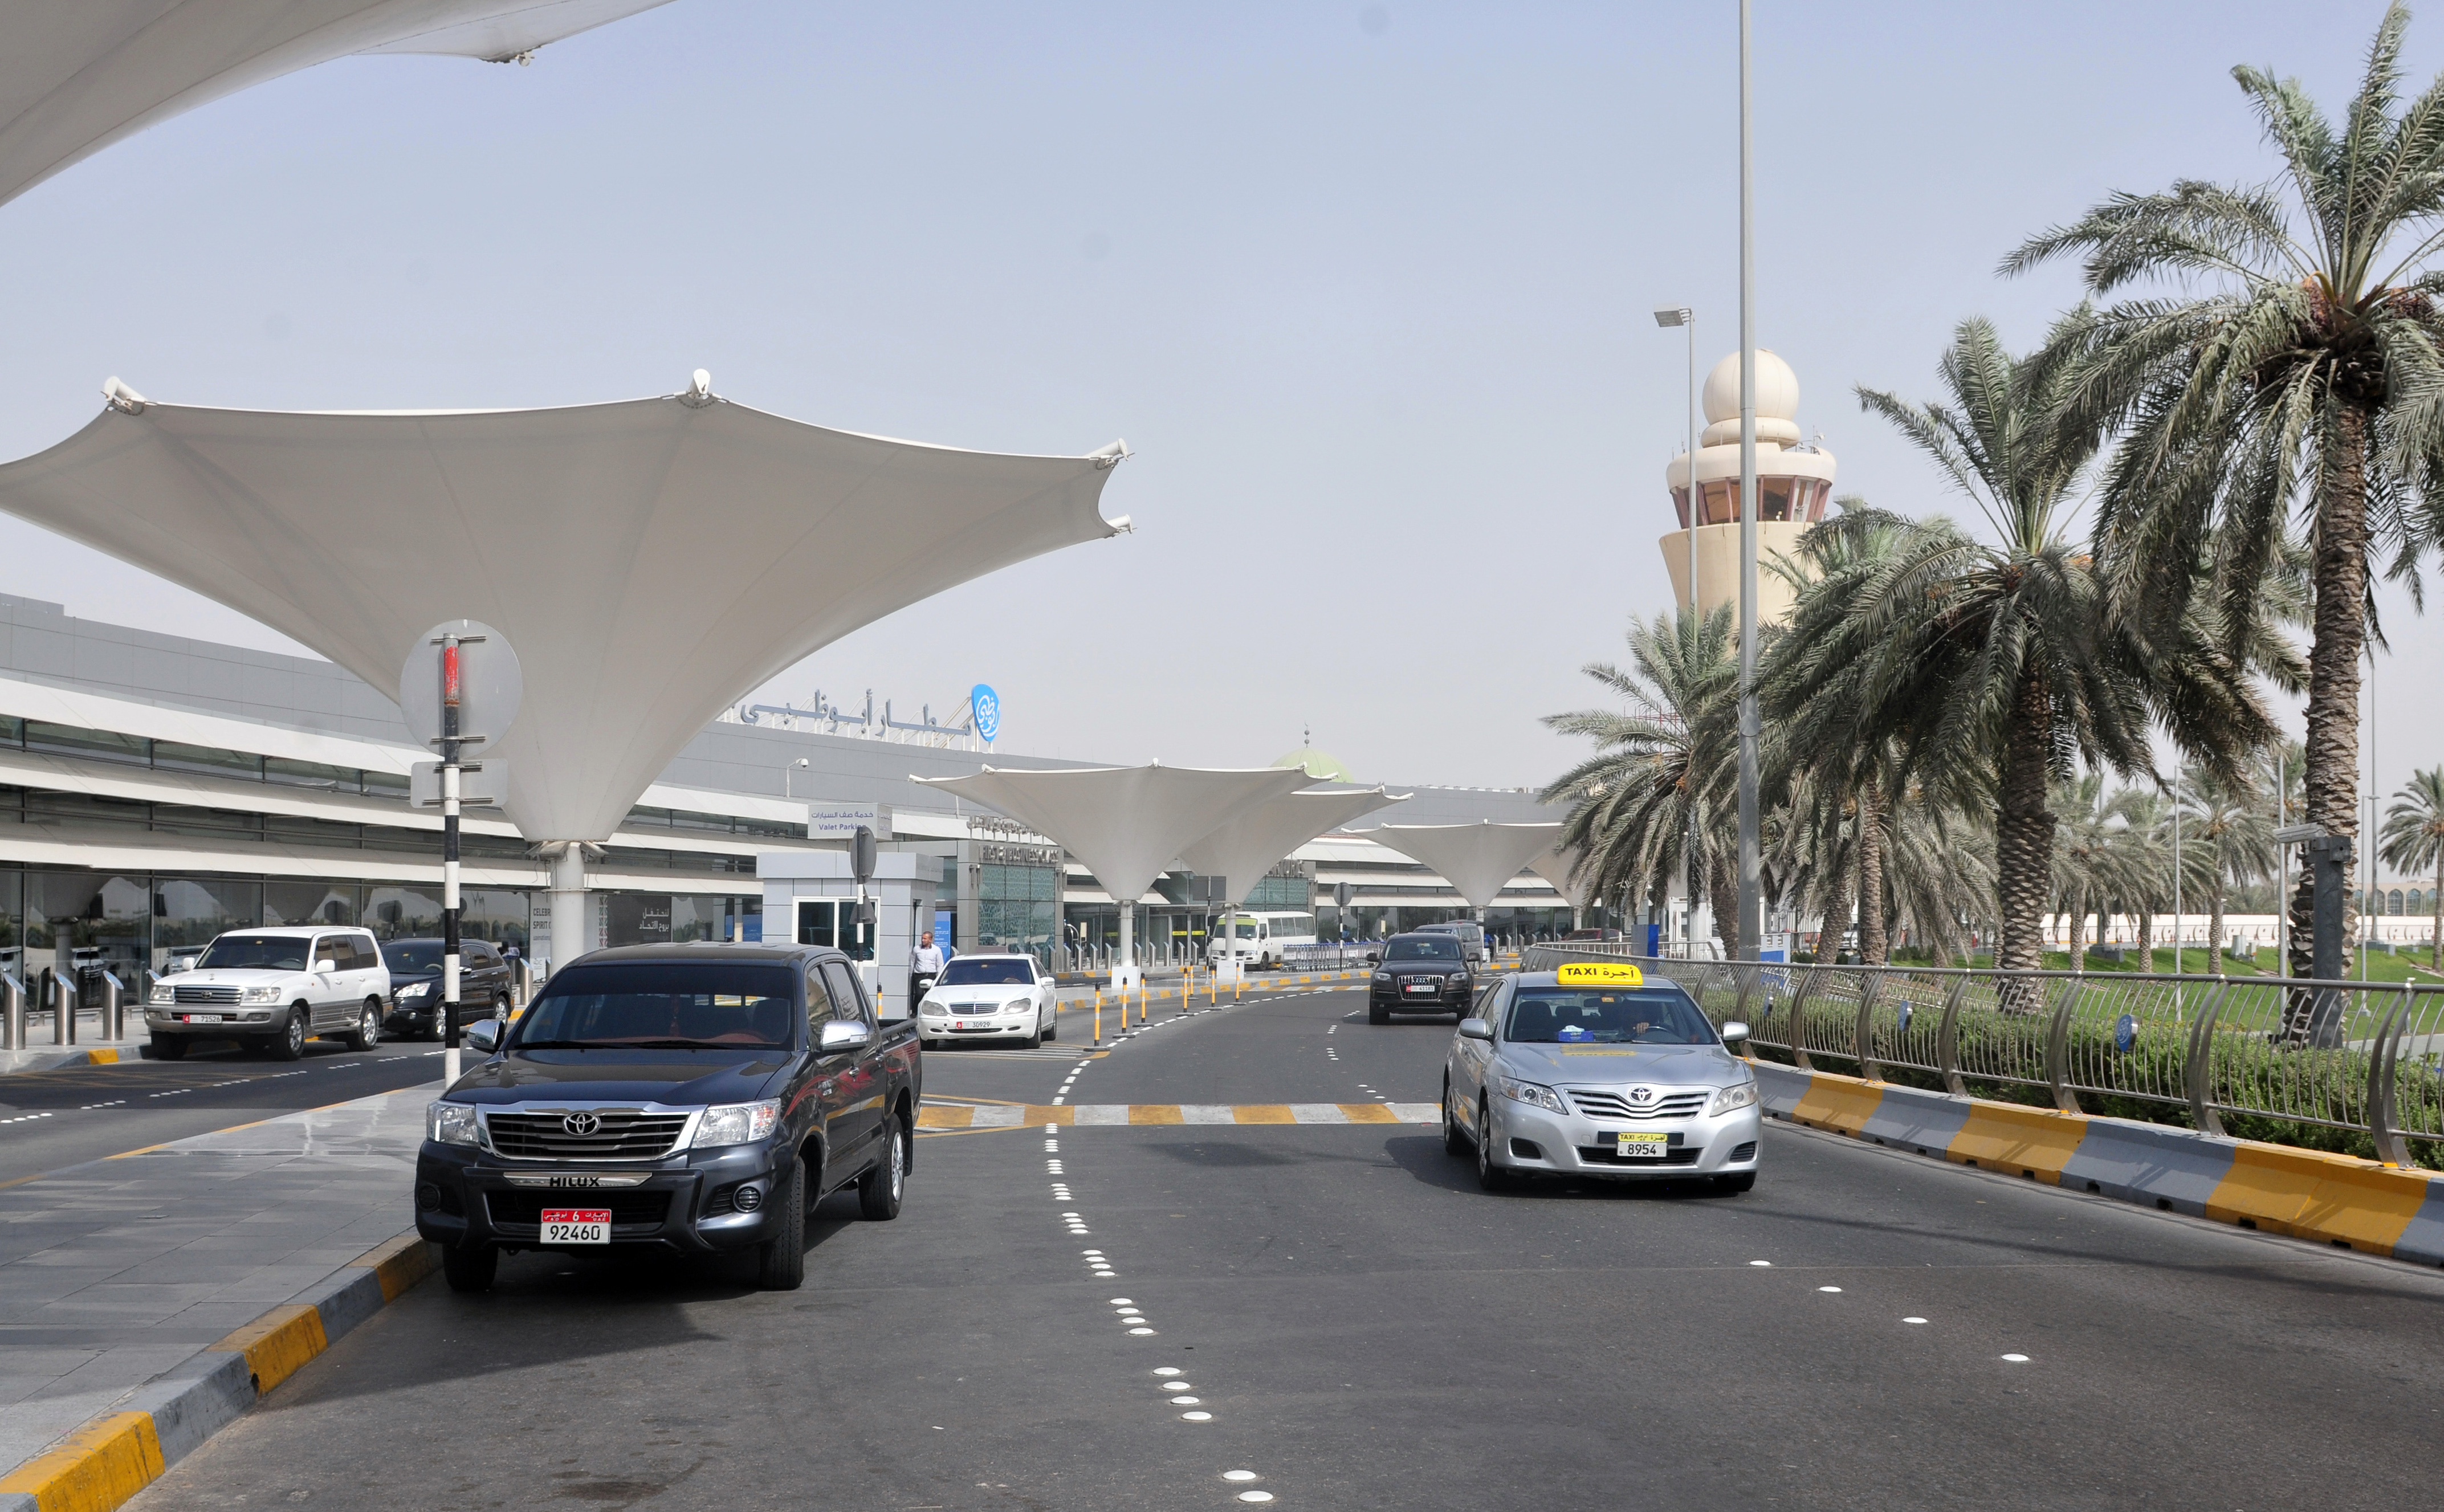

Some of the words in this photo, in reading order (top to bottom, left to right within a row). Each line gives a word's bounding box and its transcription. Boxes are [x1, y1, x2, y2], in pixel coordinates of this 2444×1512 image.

[642, 907, 669, 919] لنحتفل
[658, 923, 669, 932] بروح
[1603, 966, 1634, 979] أجرة
[1627, 1144, 1657, 1155] 8954
[549, 1177, 600, 1187] HILUX
[572, 1211, 580, 1221] 6
[550, 1225, 600, 1241] 92460
